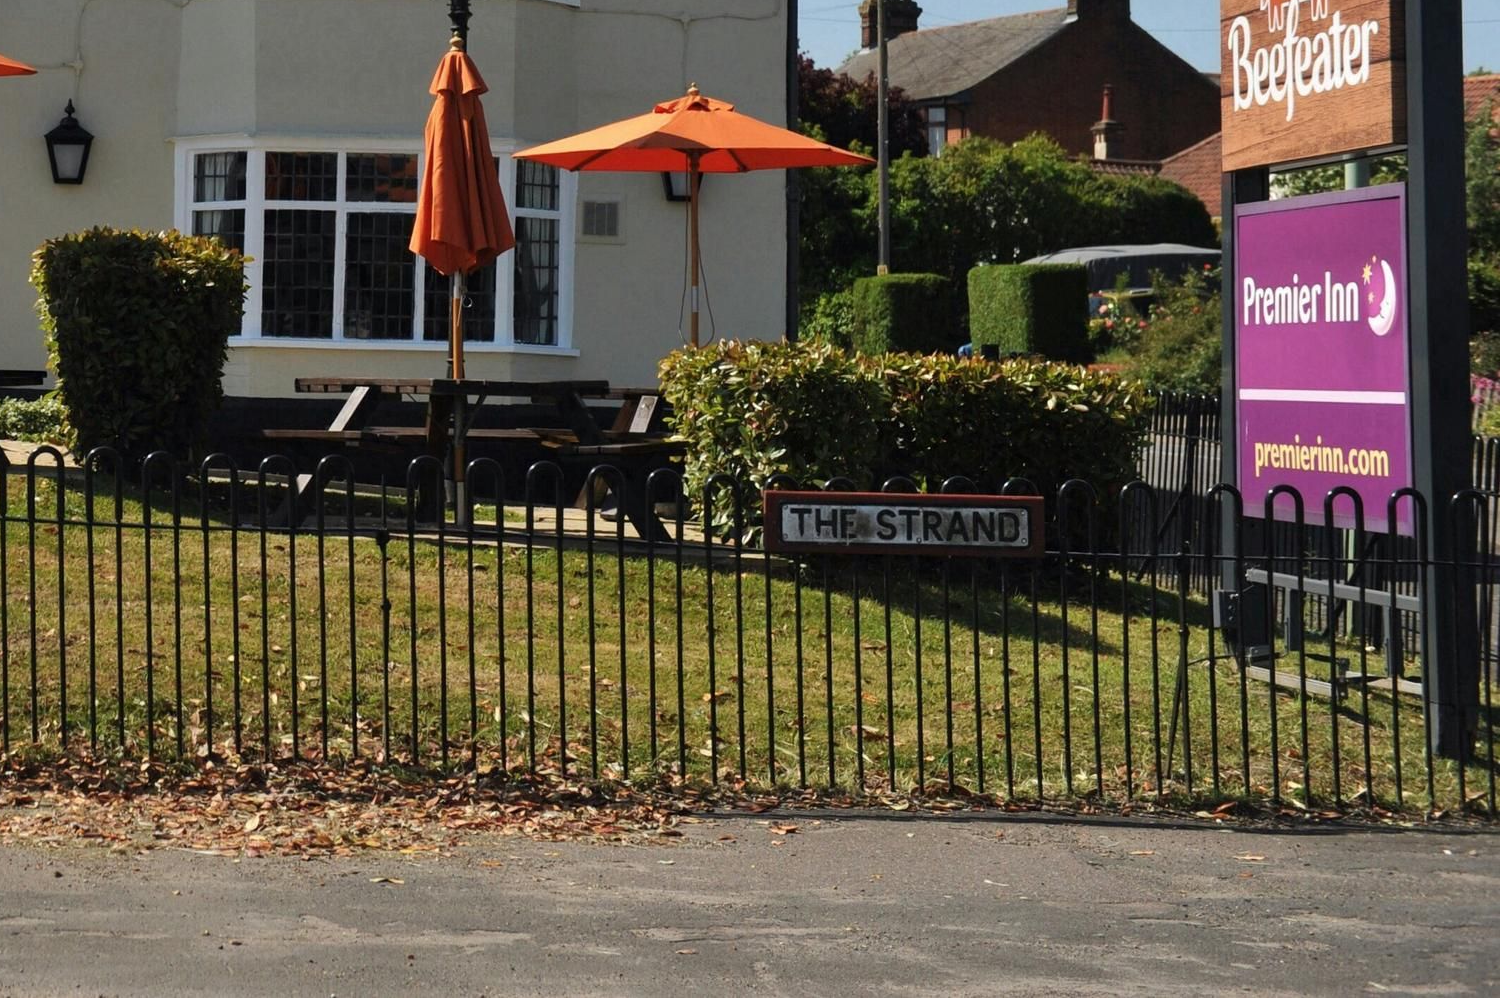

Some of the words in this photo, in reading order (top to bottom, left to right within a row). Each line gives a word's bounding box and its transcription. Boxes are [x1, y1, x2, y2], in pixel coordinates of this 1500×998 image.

[1243, 273, 1322, 326] Premier
[1325, 271, 1359, 323] Inn
[1254, 434, 1389, 477] premierinn.com
[790, 507, 857, 539] THE
[876, 508, 1020, 543] STRAND
